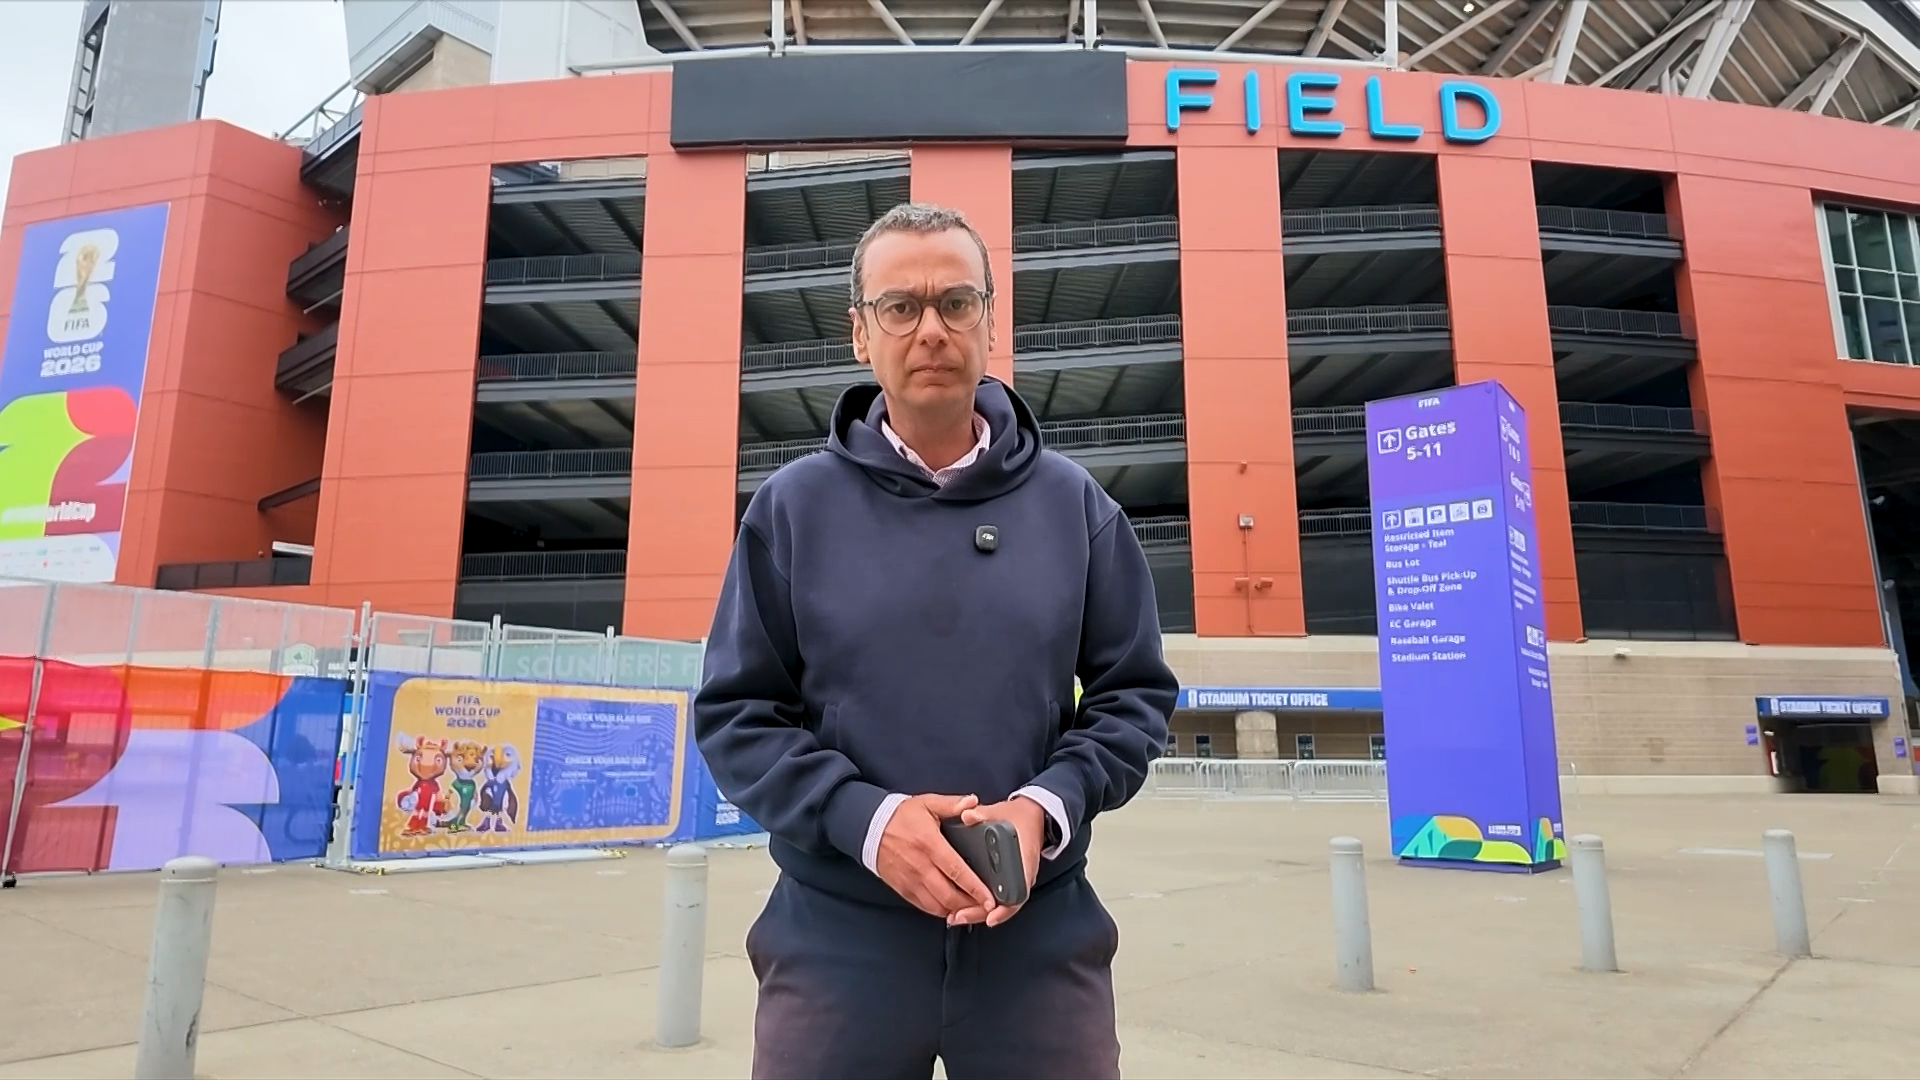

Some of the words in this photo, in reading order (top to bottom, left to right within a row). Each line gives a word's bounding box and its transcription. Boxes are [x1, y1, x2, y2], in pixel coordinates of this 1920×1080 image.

[1165, 69, 1501, 145] FIELD
[64, 318, 90, 332] FIFA
[44, 343, 80, 359] WORLD
[82, 341, 104, 354] CUP
[40, 355, 101, 377] 2026
[1418, 397, 1440, 408] FIFA
[1405, 421, 1456, 440] Gates
[1407, 441, 1441, 460] 5-11
[1384, 529, 1430, 542] Restricted
[1432, 528, 1455, 538] Item
[1384, 542, 1420, 553] Storage
[1428, 539, 1447, 549] Teal
[1385, 560, 1403, 569] Bus
[1404, 559, 1420, 568] Lot
[1386, 575, 1420, 586] Shuttle
[1421, 573, 1439, 583] Bus
[1439, 582, 1463, 592] Zone
[1388, 602, 1409, 613] Bike
[1410, 601, 1435, 611] Valet
[1403, 618, 1437, 629] Garage
[1431, 634, 1466, 644] Garage
[1391, 652, 1430, 662] Stadium
[1432, 651, 1466, 661] Station
[517, 655, 672, 677] SOUNERS
[456, 695, 480, 705] FIFA
[1199, 692, 1250, 706] STADIUM
[1250, 692, 1289, 706] TICKET
[1290, 693, 1328, 707] OFFICE
[434, 706, 476, 716] WORLD
[478, 707, 501, 717] CUP
[446, 717, 487, 728] 2026
